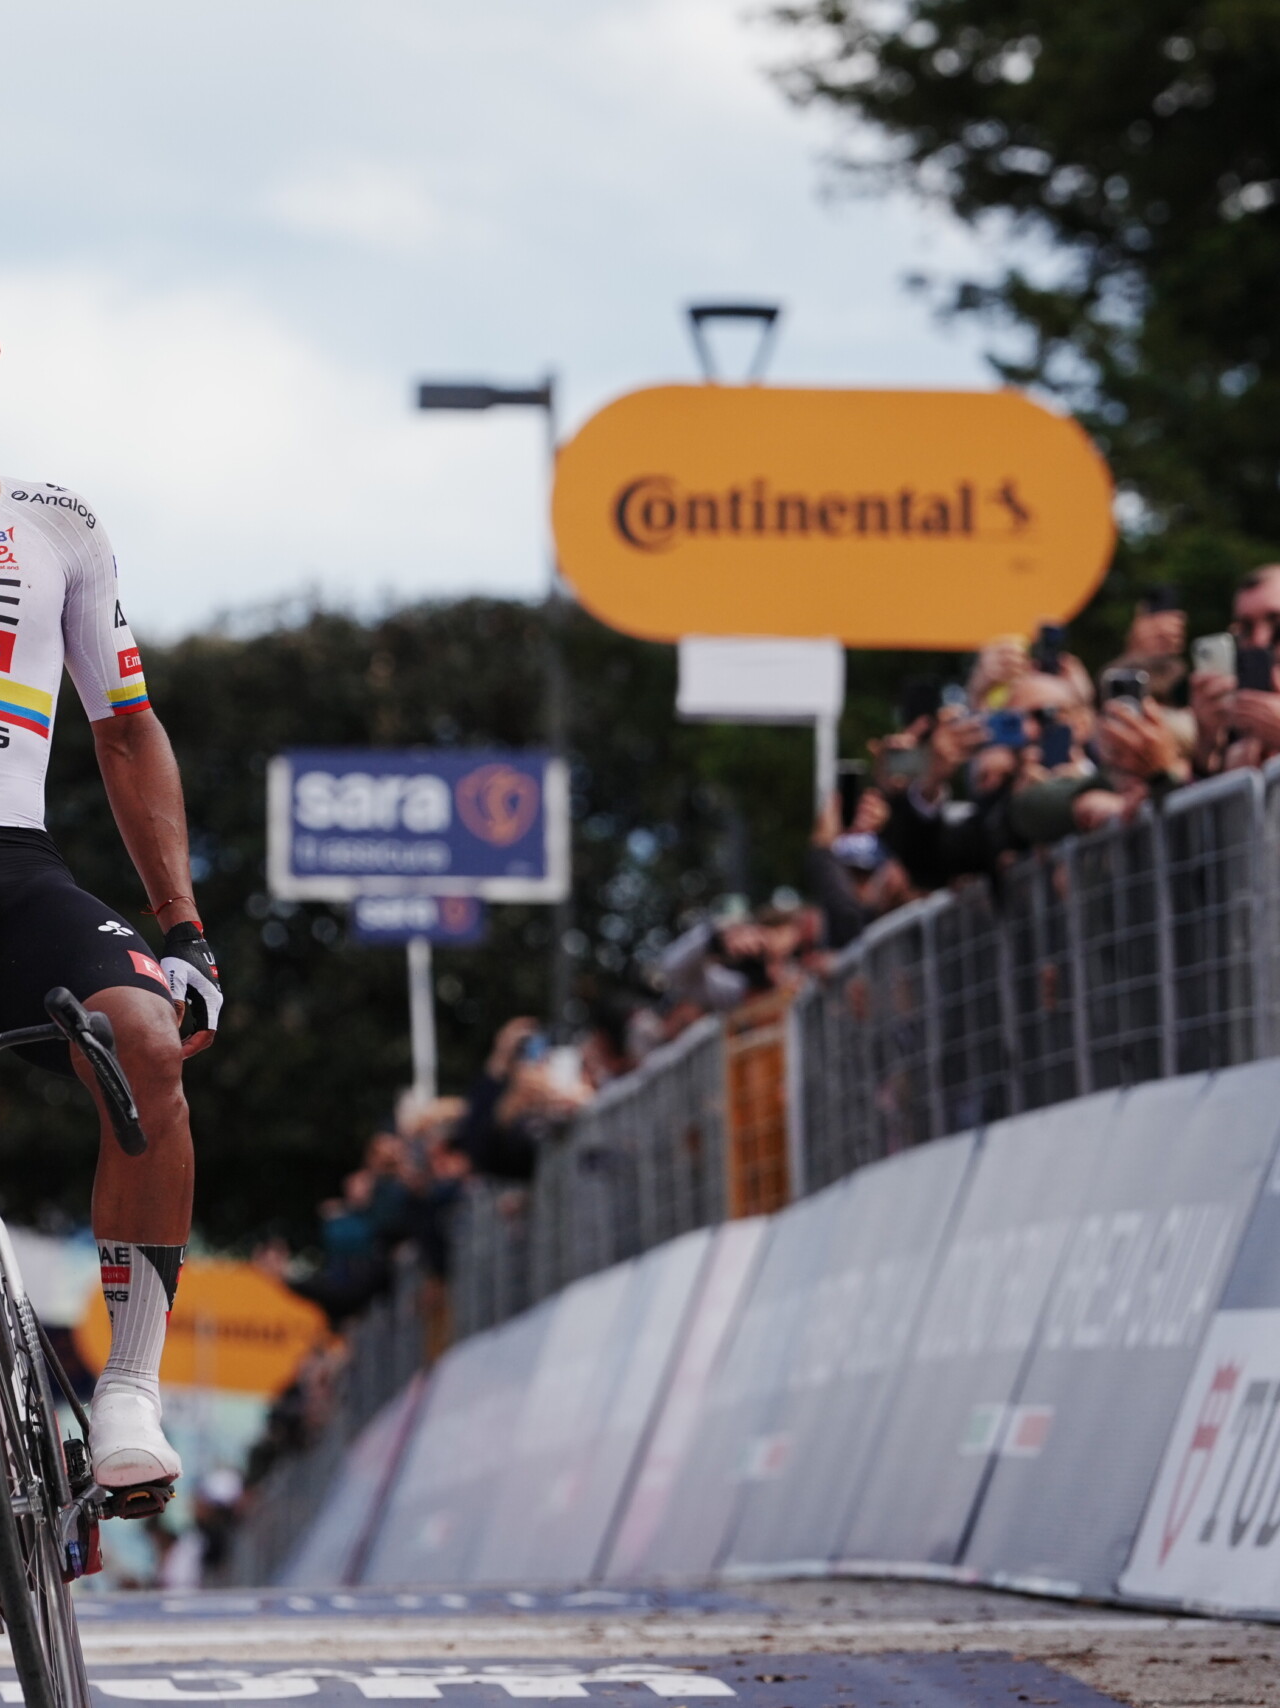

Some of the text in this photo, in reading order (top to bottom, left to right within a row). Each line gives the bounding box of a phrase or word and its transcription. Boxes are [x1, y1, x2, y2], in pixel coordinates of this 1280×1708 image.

[29, 493, 97, 529] Analog
[613, 476, 975, 552] Continental
[296, 771, 451, 833] sara
